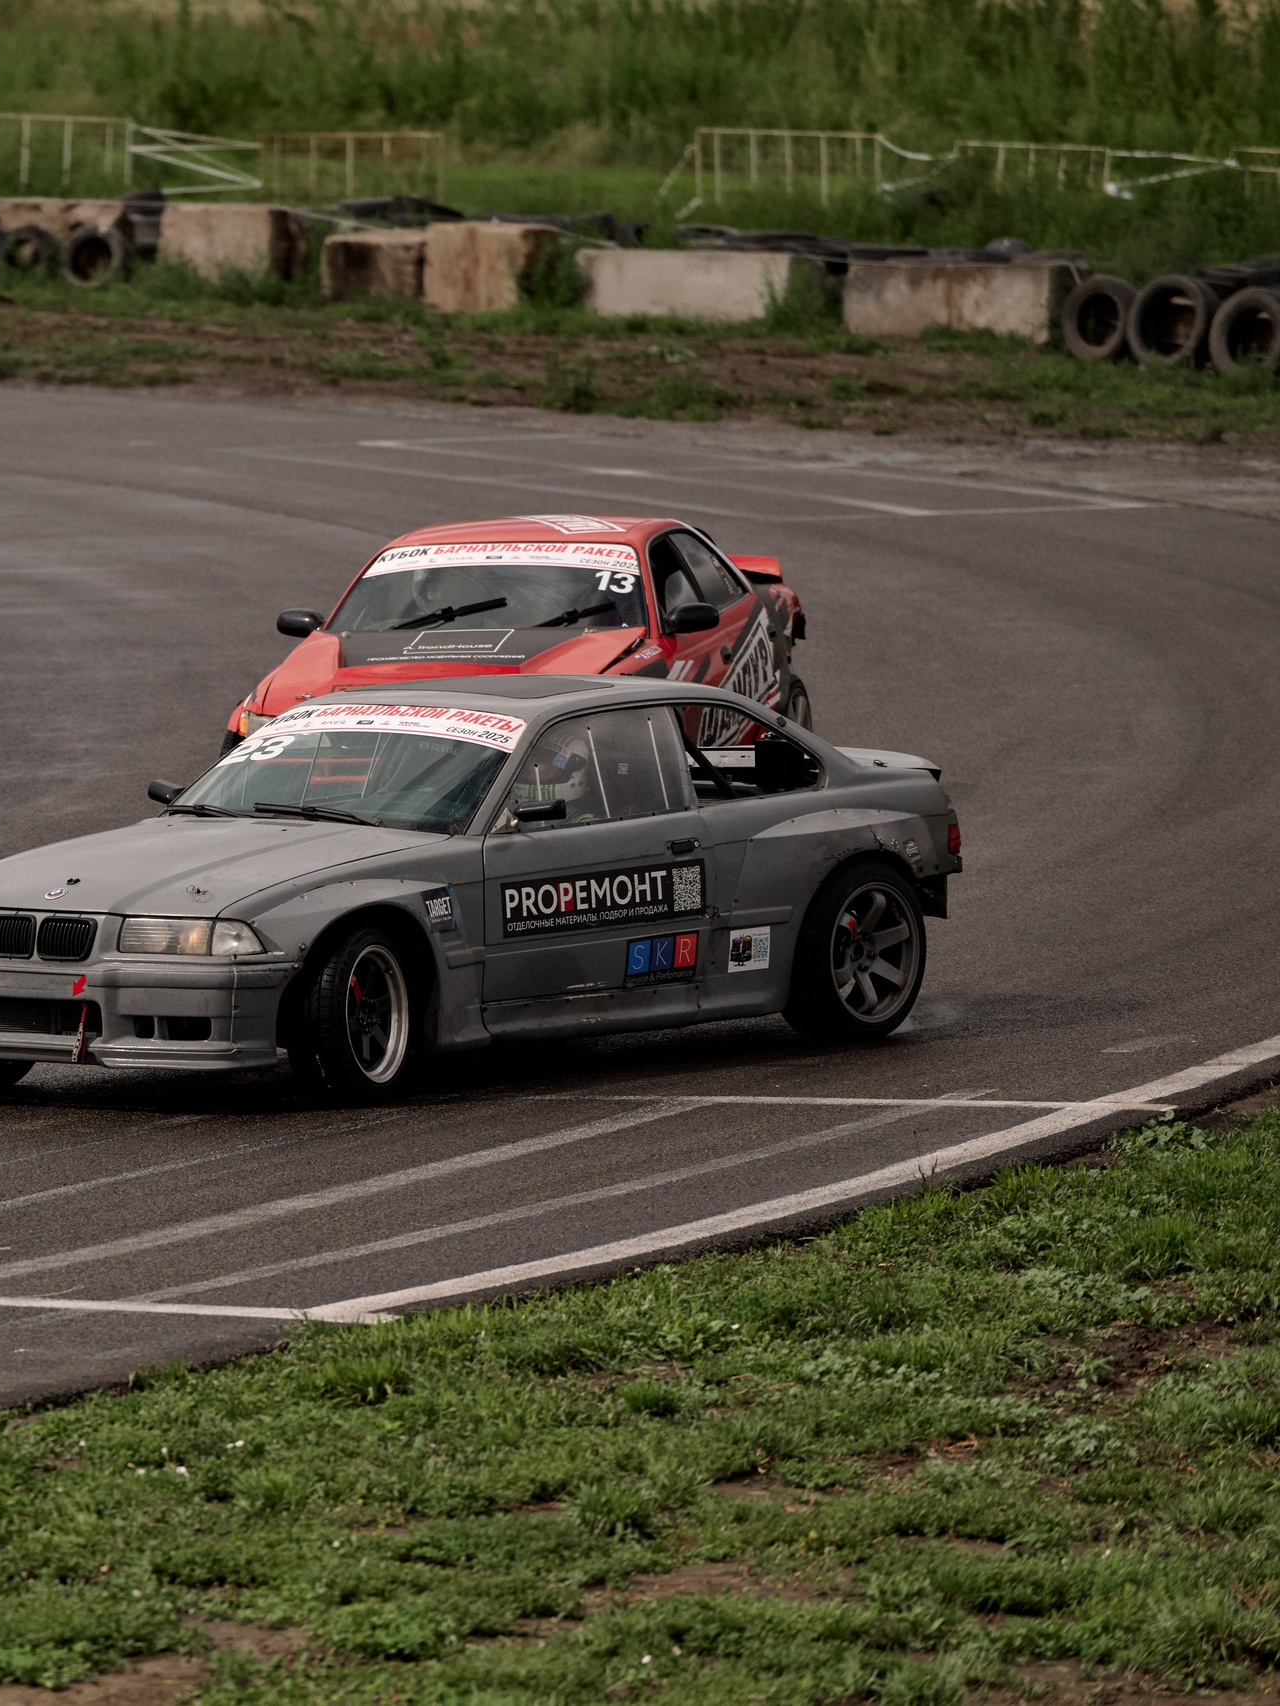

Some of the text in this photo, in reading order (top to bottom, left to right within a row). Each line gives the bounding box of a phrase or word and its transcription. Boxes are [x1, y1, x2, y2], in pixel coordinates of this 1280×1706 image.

[377, 547, 432, 564] КУБОК
[433, 543, 568, 555] БАРНАУЛЬСКОЙ
[579, 558, 610, 566] СЕЗОН
[595, 570, 636, 594] 13
[265, 708, 320, 728] КУБОК
[446, 710, 524, 733] РАКЕТЫ
[446, 726, 513, 744] СЕЗОН 2025
[217, 735, 296, 767] 23
[425, 896, 452, 918] TARGET
[507, 918, 555, 932] ОТДЕЛОЧНЫЕ
[600, 908, 628, 920] ПОДБОР
[628, 908, 634, 917] И
[634, 904, 669, 916] ПРОДАЖА
[632, 938, 691, 970] SKR
